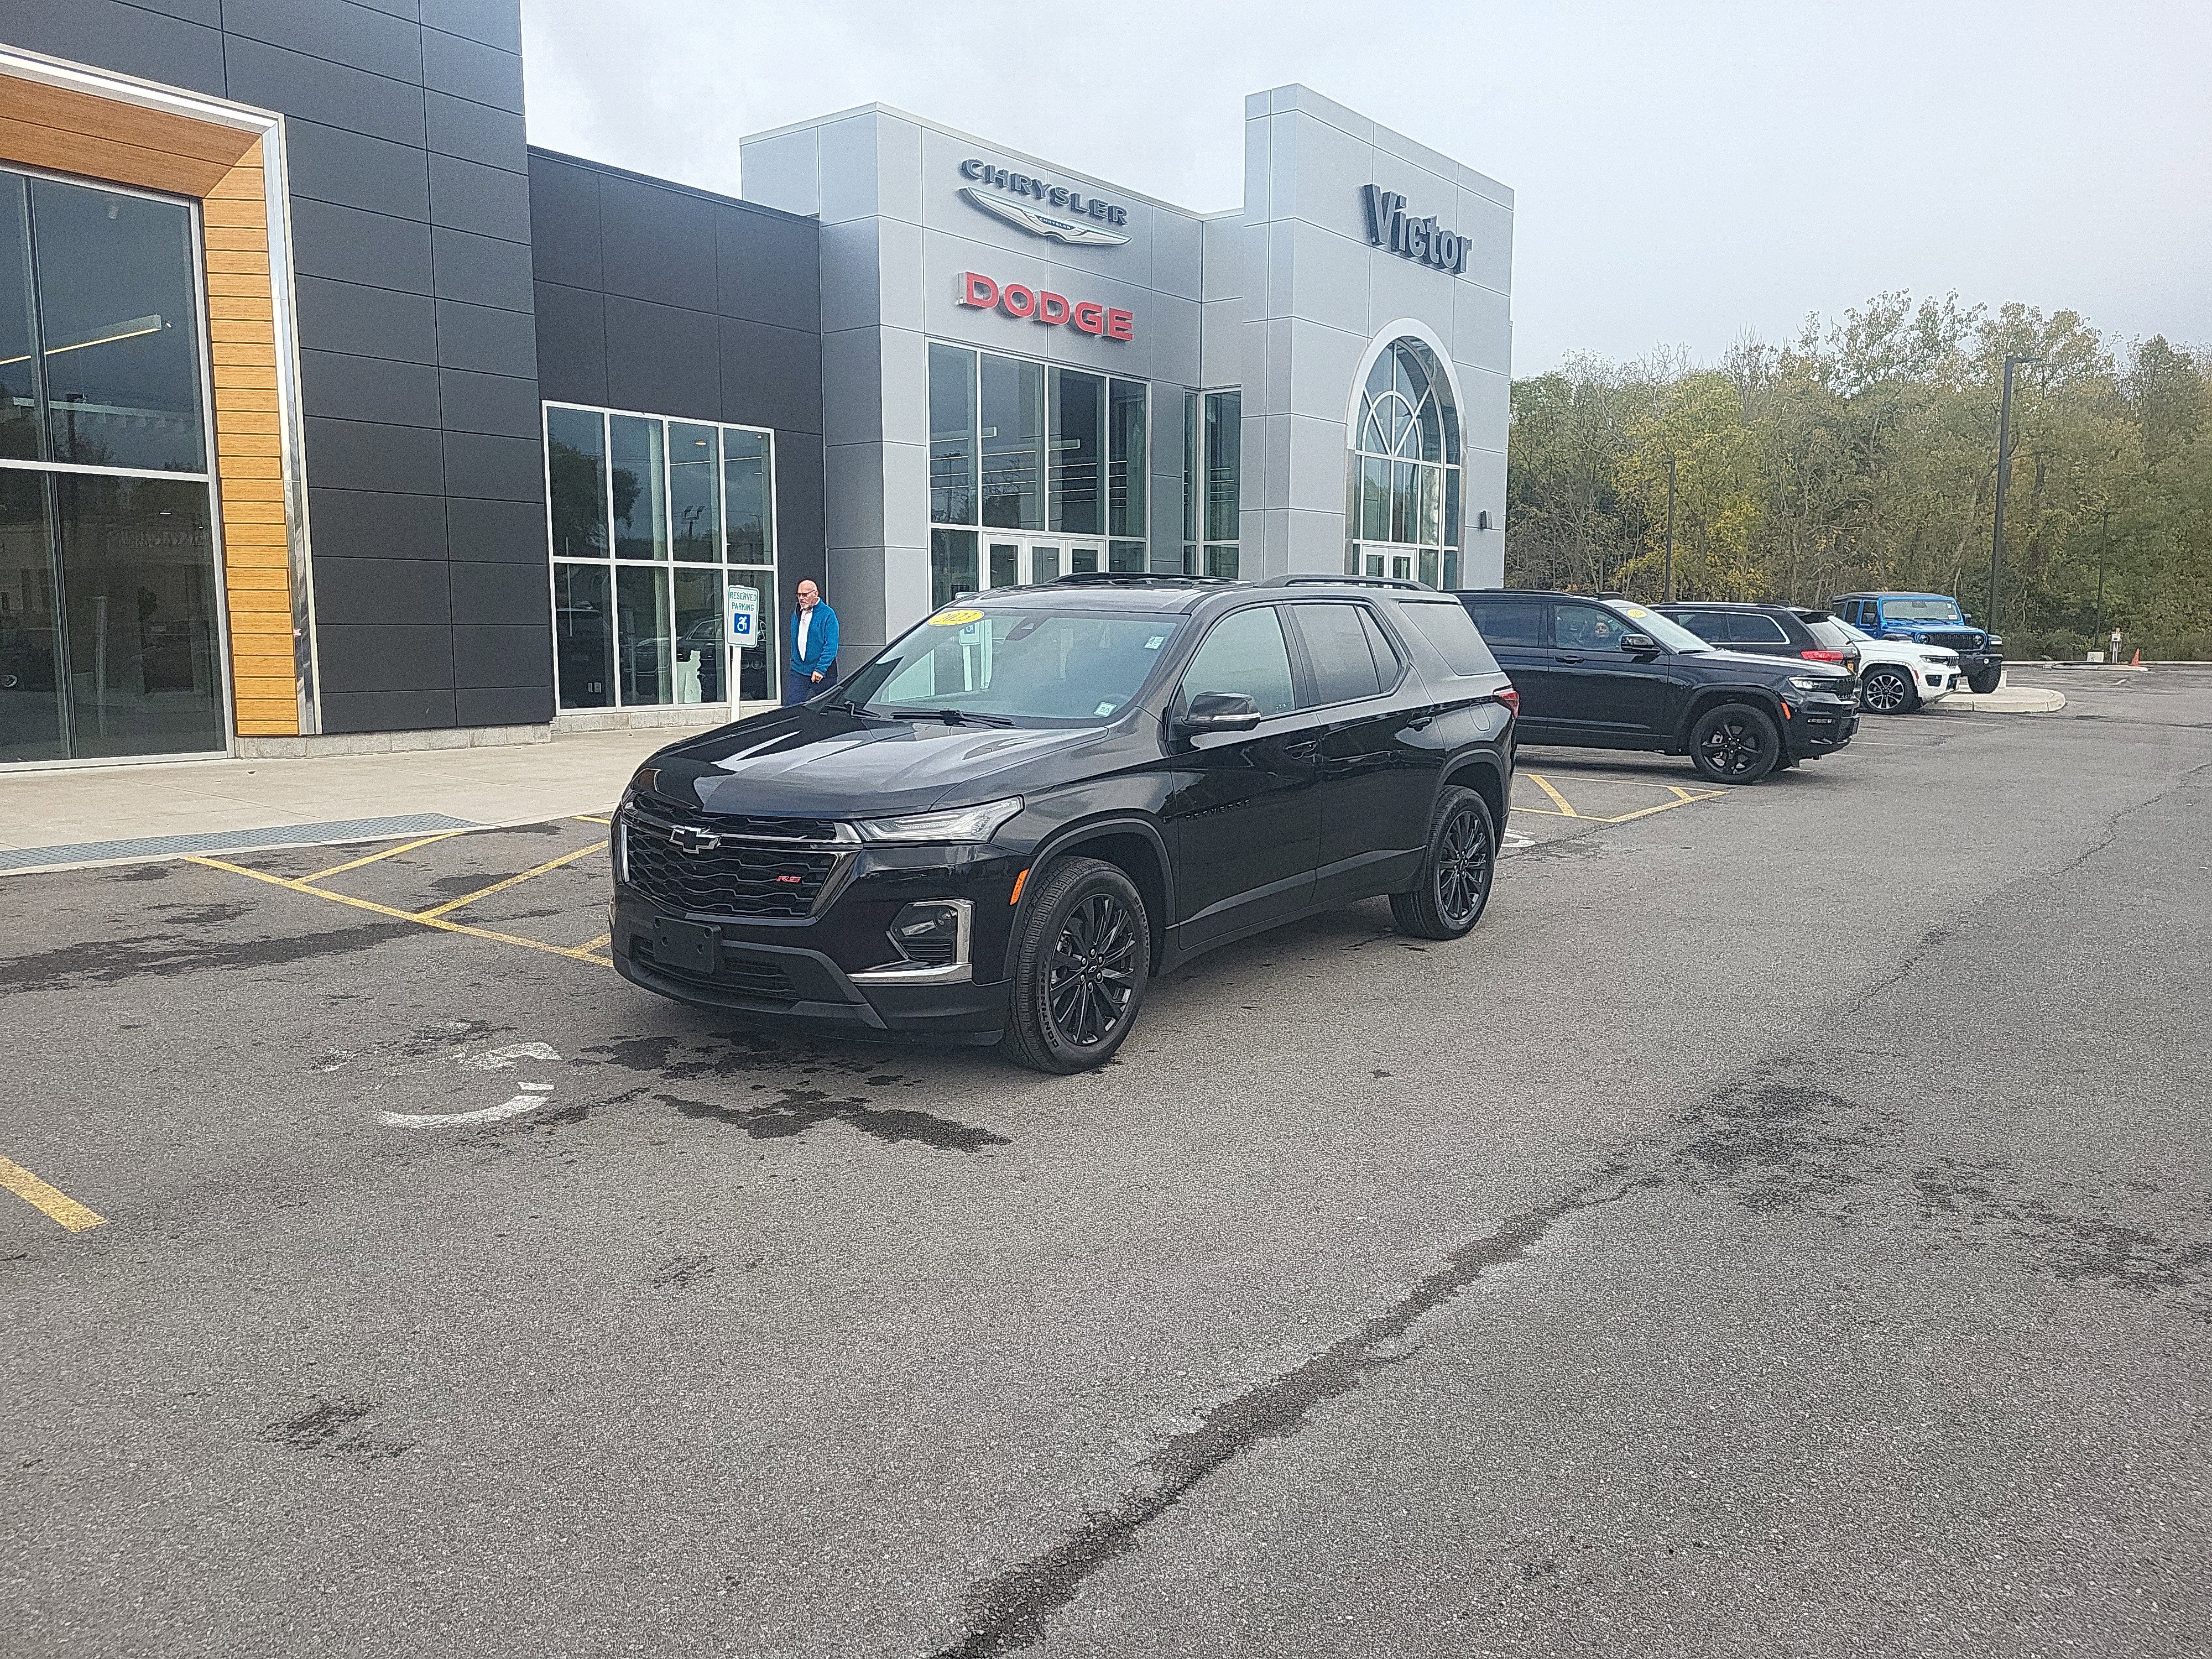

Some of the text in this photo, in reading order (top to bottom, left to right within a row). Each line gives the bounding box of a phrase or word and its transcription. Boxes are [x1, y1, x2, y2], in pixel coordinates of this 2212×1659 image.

[961, 159, 1128, 225] CHRYSLER
[1364, 184, 1473, 275] Victor
[958, 271, 1133, 341] DODGE
[729, 591, 757, 602] RESERVED
[732, 602, 754, 612] PARKING
